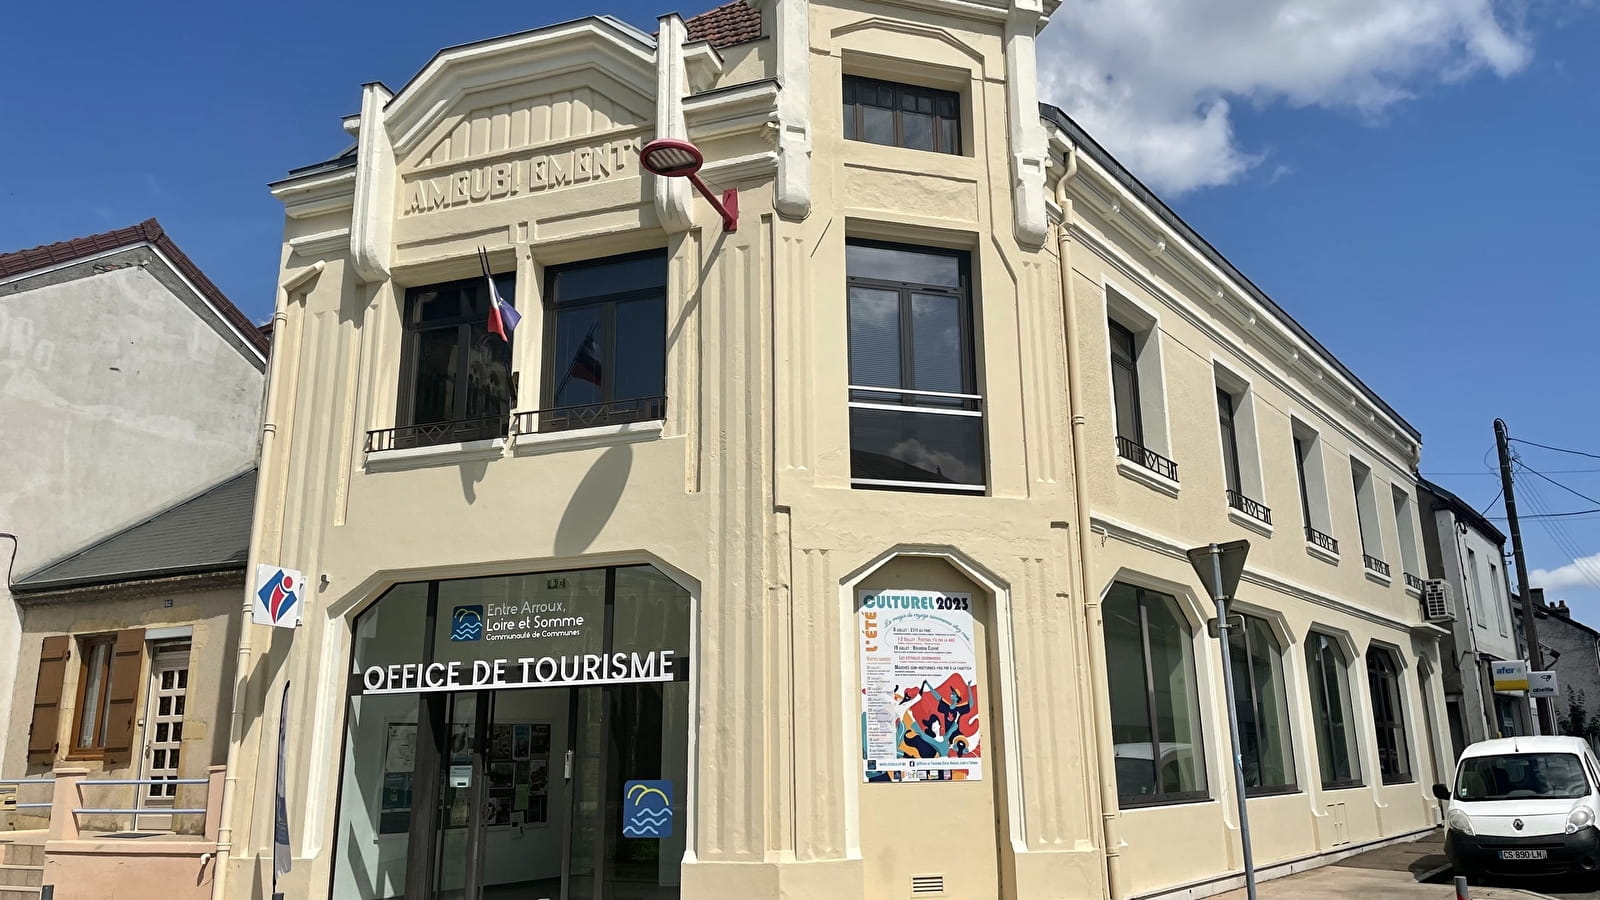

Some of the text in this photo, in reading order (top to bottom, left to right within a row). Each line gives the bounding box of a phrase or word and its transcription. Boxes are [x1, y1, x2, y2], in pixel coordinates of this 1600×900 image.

[487, 601, 566, 617] Entre Arroux,
[863, 595, 969, 610] CULTUREL 2023
[486, 615, 584, 631] Loire et Somme
[485, 629, 580, 641] Communauté de Communes
[861, 611, 878, 652] L'ÉTÉ
[363, 650, 675, 690] OFFICE DE TOURISME
[1503, 851, 1514, 859] CS
[1515, 851, 1530, 859] 890
